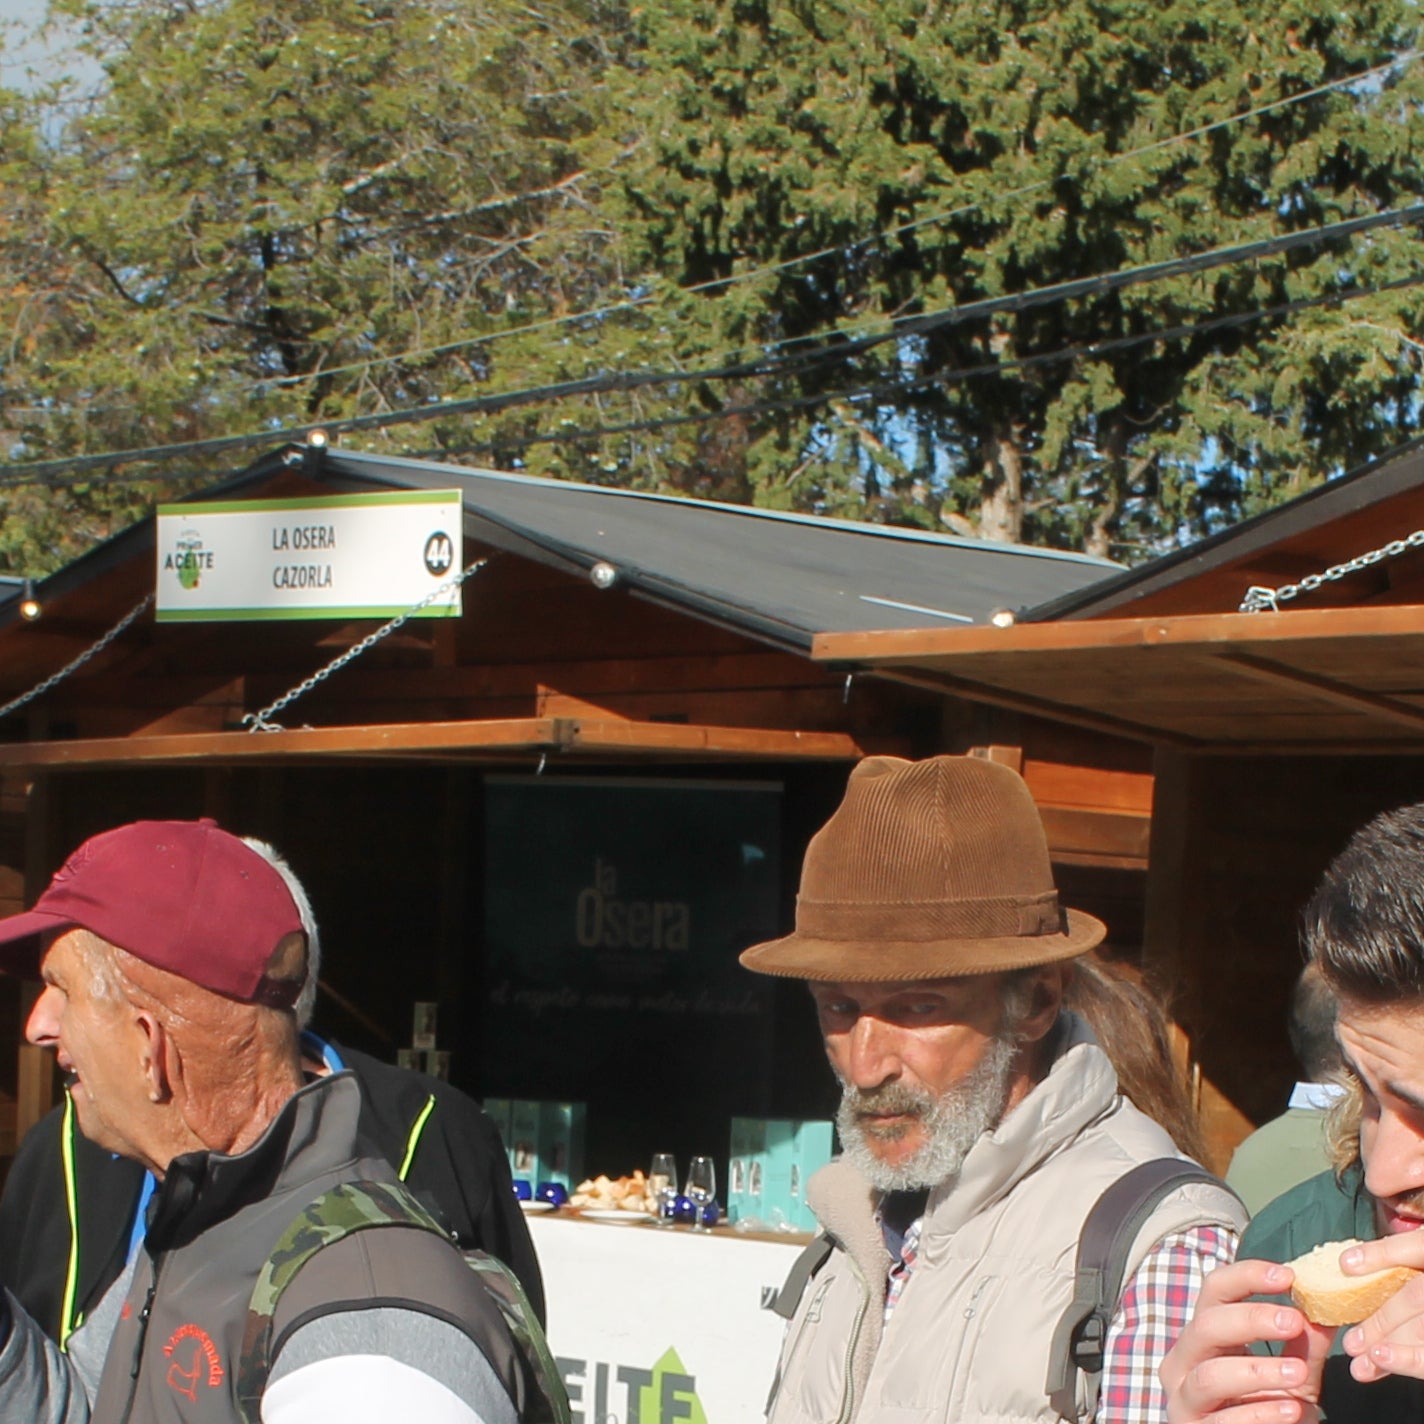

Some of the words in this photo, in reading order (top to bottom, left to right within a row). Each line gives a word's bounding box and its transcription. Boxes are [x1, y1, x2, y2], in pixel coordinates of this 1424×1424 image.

[273, 528, 289, 550] LA
[293, 526, 335, 549] OSERA
[164, 552, 214, 570] ACEITE
[425, 537, 451, 568] 44
[272, 565, 333, 588] CAZORLA
